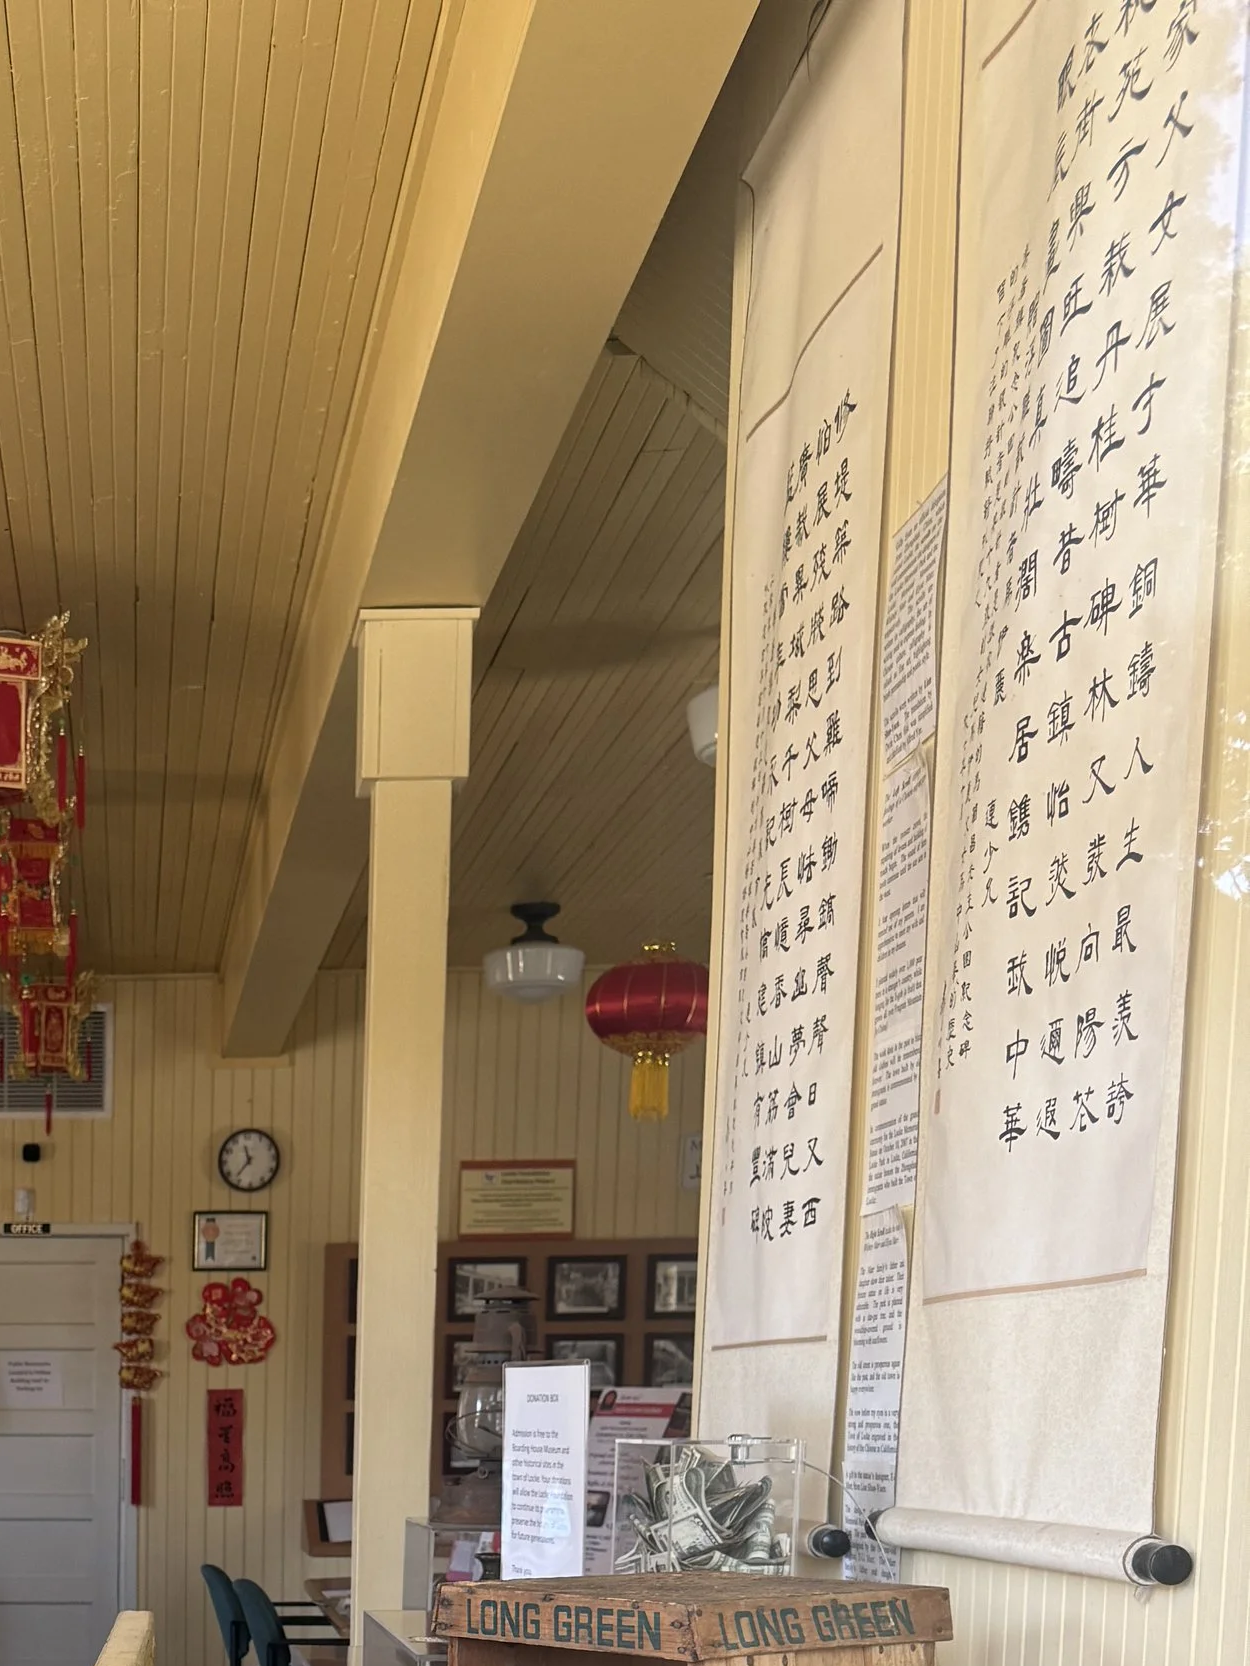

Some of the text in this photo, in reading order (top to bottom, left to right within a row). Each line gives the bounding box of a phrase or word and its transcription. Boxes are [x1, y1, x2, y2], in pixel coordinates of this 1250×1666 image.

[10, 1224, 43, 1234] OFFICE
[465, 1598, 662, 1652] LONG GREEN
[717, 1598, 916, 1653] LONG GREEN
